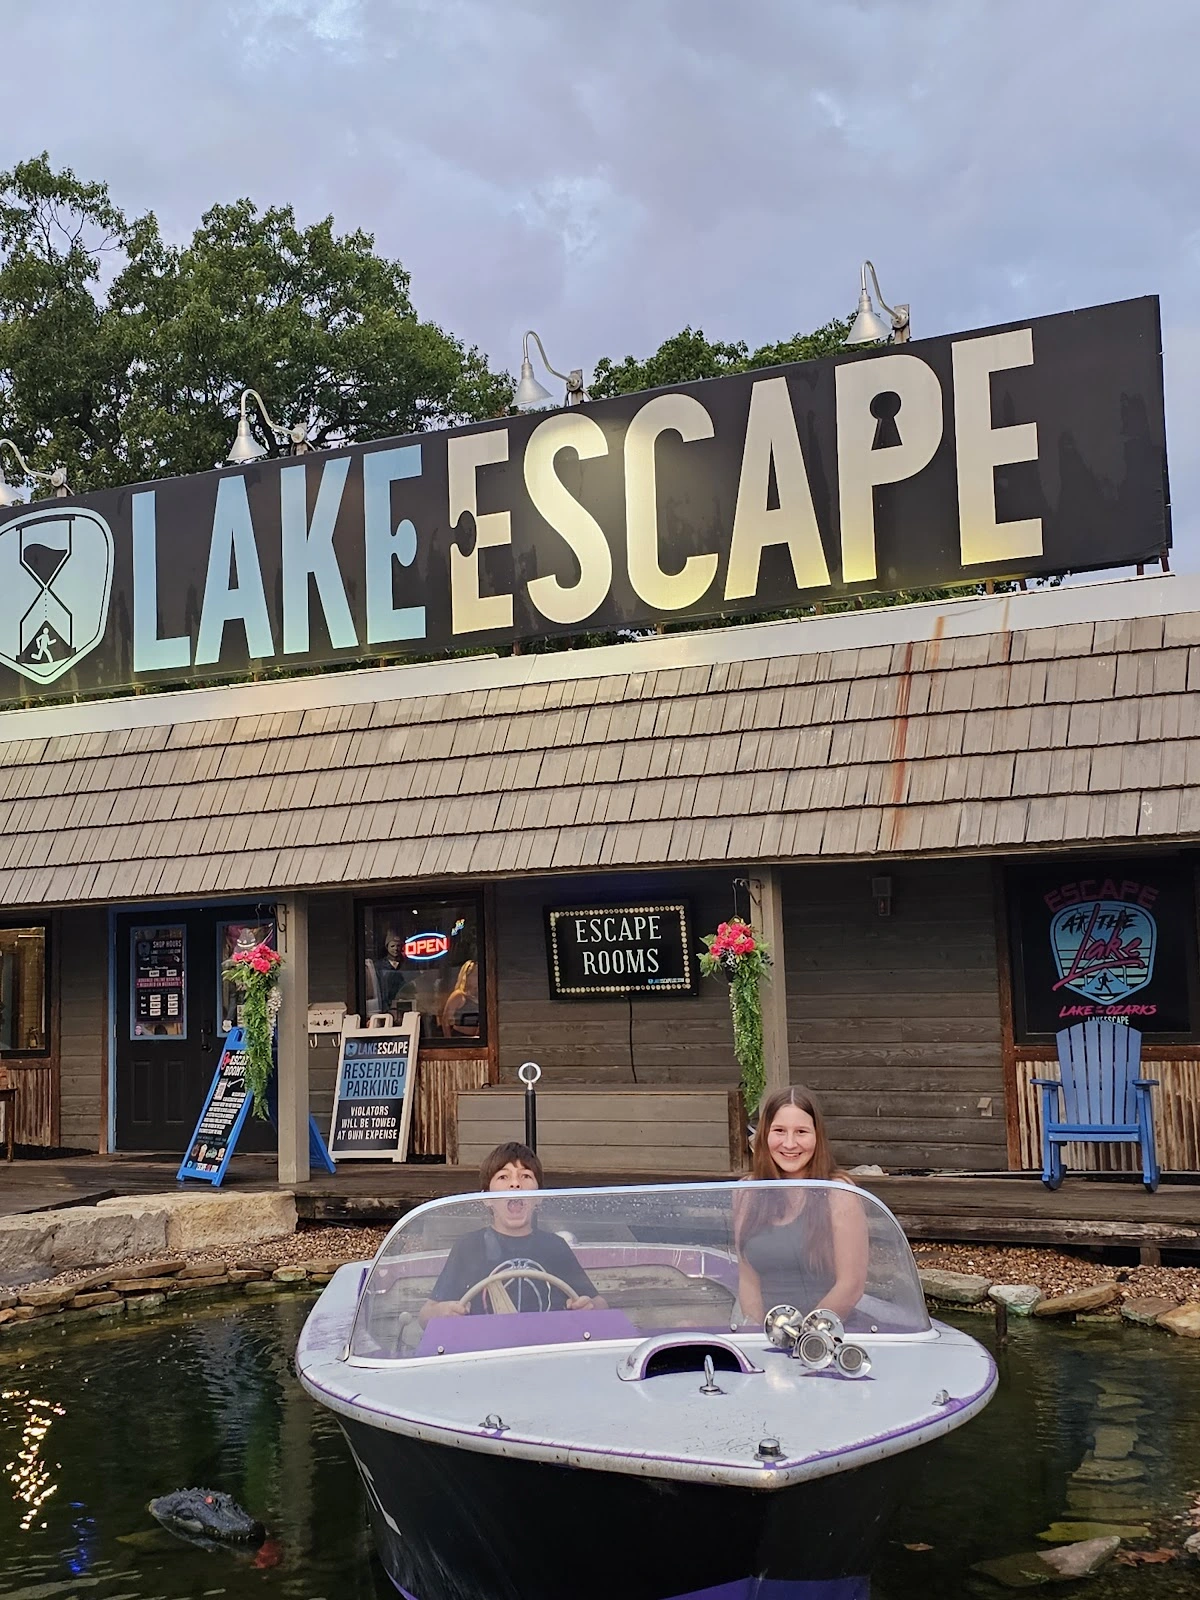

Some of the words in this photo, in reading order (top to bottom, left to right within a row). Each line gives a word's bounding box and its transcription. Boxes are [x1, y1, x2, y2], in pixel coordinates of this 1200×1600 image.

[132, 443, 426, 672] LAKE
[447, 328, 1044, 635] ESCAPE
[1042, 879, 1160, 912] ESCAPE
[575, 915, 662, 943] ESCAPE
[1061, 911, 1088, 935] AT
[1095, 911, 1138, 931] THE
[405, 938, 448, 956] OPEN
[1052, 902, 1145, 991] Lake
[582, 949, 659, 975] ROOMS
[1058, 1005, 1095, 1018] LAKE
[1105, 1005, 1157, 1016] OZARKS
[344, 1061, 406, 1079] RESERVED
[346, 1079, 399, 1097] PARKING
[350, 1105, 389, 1117] VIOLATORS
[341, 1118, 358, 1128] WILL
[360, 1118, 369, 1128] BE
[371, 1117, 397, 1128] TOWED
[336, 1130, 346, 1140] AT
[347, 1129, 364, 1140] OWN
[365, 1129, 398, 1140] EXPENSE
